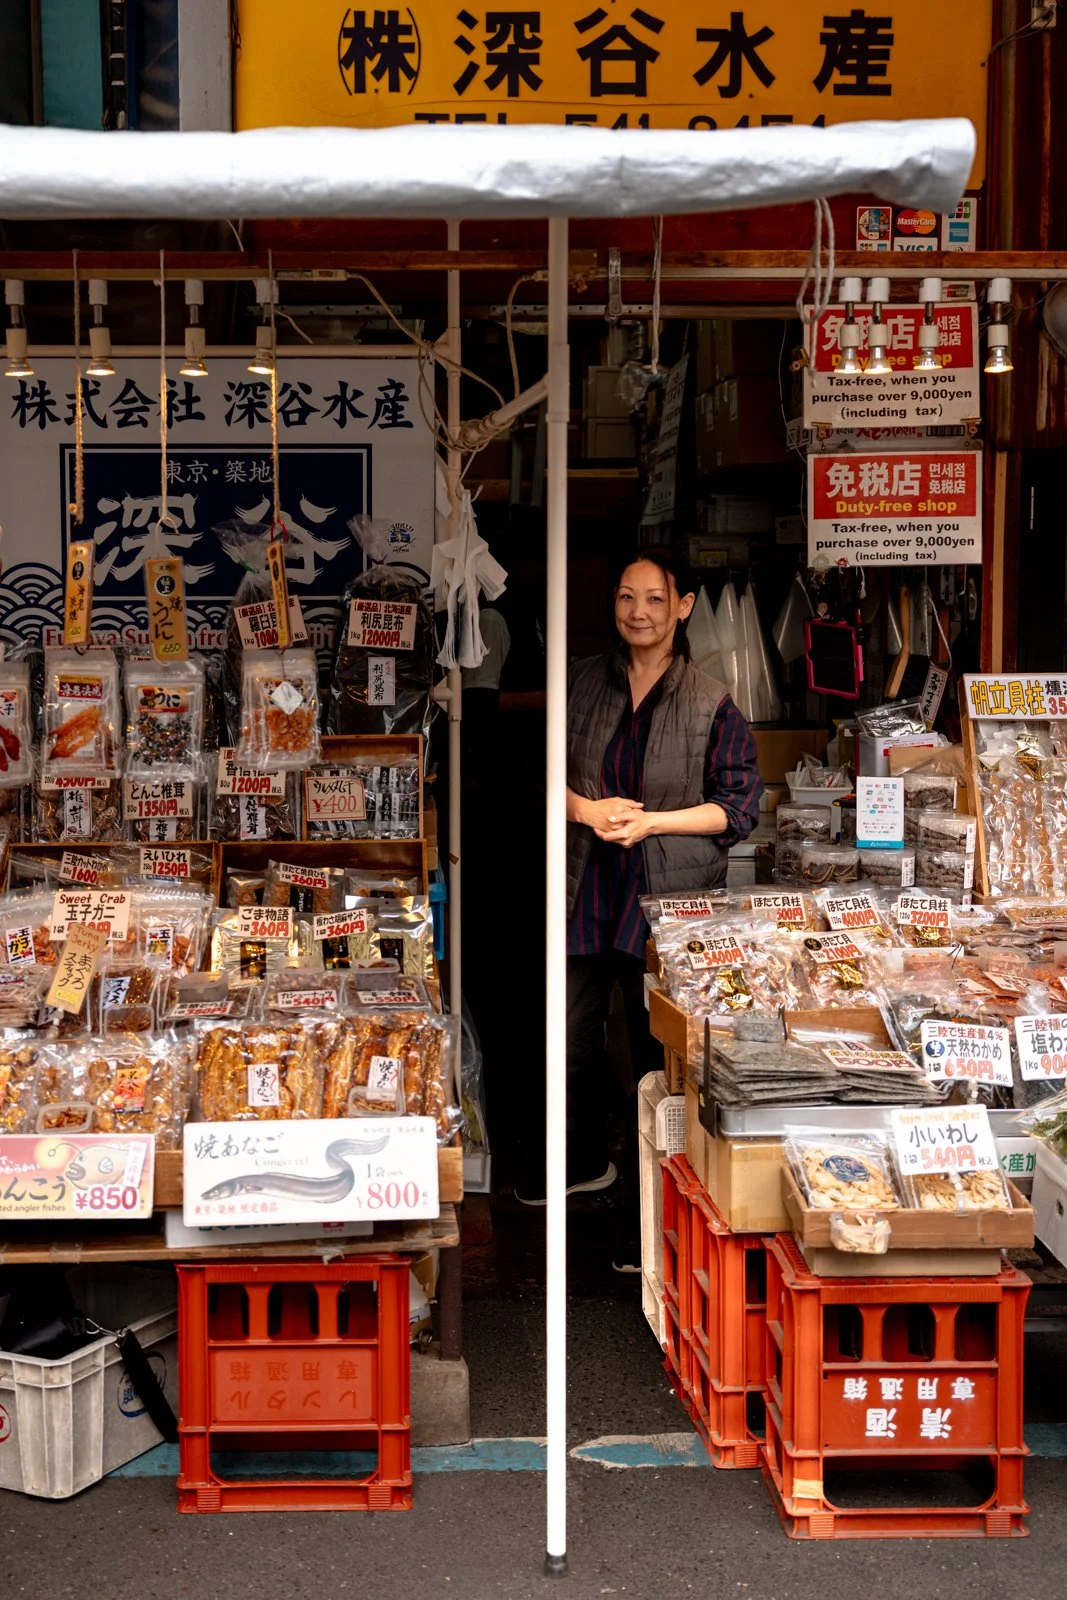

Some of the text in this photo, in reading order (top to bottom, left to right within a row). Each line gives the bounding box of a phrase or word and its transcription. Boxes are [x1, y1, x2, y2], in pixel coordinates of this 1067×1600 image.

[896, 216, 935, 227] MasterCard
[828, 374, 955, 388] Tax-free, when you
[10, 378, 414, 431] 株式会社 深谷水産
[812, 389, 972, 404] purchase over 9,000yen
[841, 404, 943, 419] (including tax)
[928, 463, 966, 478] 면세점
[826, 461, 922, 498] 免税店
[928, 479, 966, 494] 免税店
[836, 499, 957, 515] Duty-free shop
[832, 522, 960, 534] Tax-free, when you
[816, 536, 975, 550] purchase over 9,000yen
[855, 549, 937, 562] (including tax)
[153, 602, 174, 641] うに
[361, 612, 404, 631] 利尻昆布
[362, 629, 401, 647] 12000円
[372, 664, 384, 702] 利尻昆布
[970, 680, 1047, 715] 帆立貝柱
[231, 777, 271, 794] 1200円
[139, 799, 177, 817] 1350円
[312, 795, 357, 814] ¥400
[143, 850, 188, 863] えいひれ
[152, 862, 188, 877] 1250円
[291, 874, 328, 888] 360円
[59, 893, 126, 904] Sweet Crab
[662, 901, 709, 909] ほたて貝柱
[753, 896, 802, 908] ほたて貝柱
[826, 897, 872, 913] ほたて貝柱
[900, 898, 948, 912] ほたて貝柱
[65, 904, 115, 921] 玉子ガニ
[241, 908, 289, 921] ごま物語
[841, 909, 878, 927] 4000円
[911, 911, 949, 926] 3200円
[52, 925, 65, 934] 1袋
[240, 921, 289, 937] 1袋 360円
[327, 920, 365, 937] 360円
[705, 937, 738, 951] ほたて貝
[820, 934, 853, 948] ほたて貝
[703, 948, 745, 967] 5400円
[822, 944, 863, 961] 2100円
[72, 954, 92, 990] まぐろ
[946, 1039, 1003, 1061] 天然わかめ
[944, 1058, 995, 1080] 650円
[996, 1073, 1009, 1082] 税込
[255, 1066, 273, 1103] 焼あなご
[909, 1122, 978, 1148] 小いわし
[194, 1132, 284, 1160] 焼あなご
[920, 1145, 977, 1169] 540円
[978, 1156, 994, 1166] 税込
[75, 1186, 138, 1210] ¥850
[14, 1202, 66, 1213] angler fishes
[230, 1389, 356, 1410] レンタル
[865, 1407, 953, 1439] 清酒
